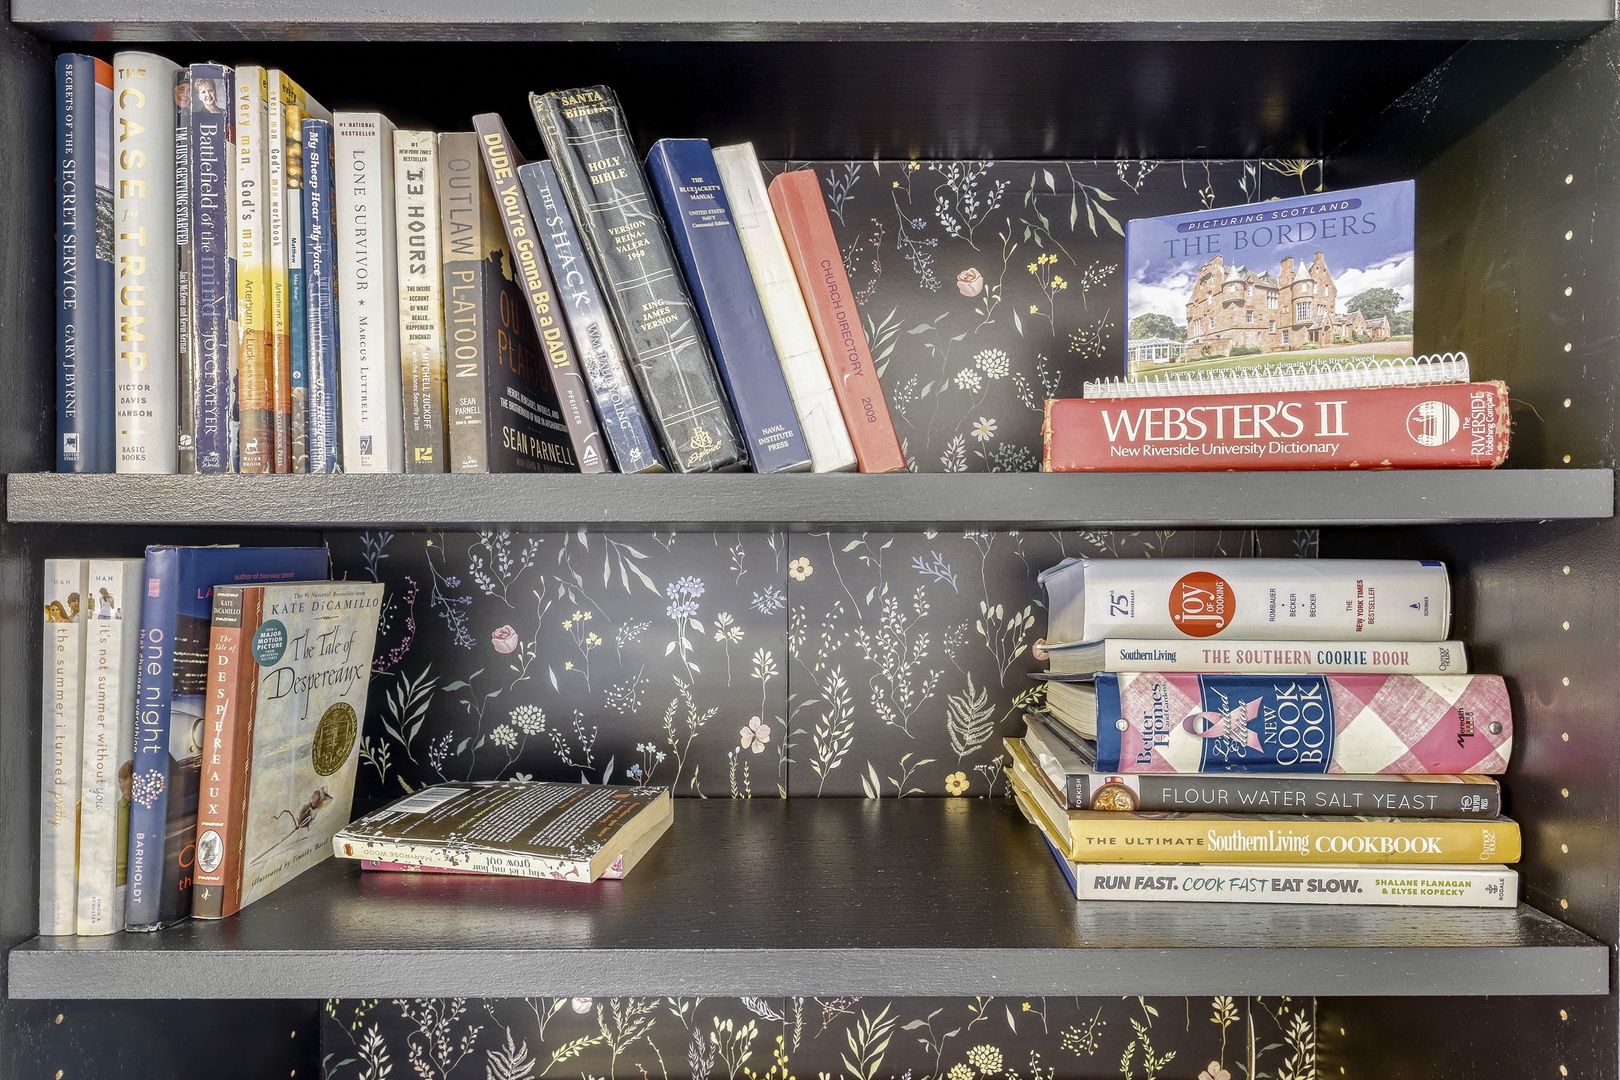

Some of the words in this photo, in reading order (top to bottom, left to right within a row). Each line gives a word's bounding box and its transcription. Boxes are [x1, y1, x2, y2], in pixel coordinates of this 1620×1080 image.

[65, 64, 73, 111] SECRETS
[118, 68, 146, 79] THE
[238, 85, 250, 127] every
[561, 91, 603, 107] SANTA
[564, 102, 609, 119] BIBLIA
[65, 114, 73, 129] OF
[176, 126, 187, 142] I'M
[65, 131, 73, 154] THE
[119, 88, 146, 199] CASE
[176, 144, 187, 165] JUST
[238, 134, 251, 171] man,
[309, 131, 318, 149] My
[200, 122, 219, 209] Battlefield
[310, 150, 321, 188] Sheep
[352, 150, 366, 196] LONE
[484, 132, 513, 185] DUDE,
[587, 156, 621, 173] HOLY
[176, 167, 188, 206] GETTING
[590, 168, 628, 186] BIBLE
[679, 185, 721, 194] BLUEJACKET'S
[62, 159, 77, 232] SECRET
[241, 179, 256, 220] God's
[311, 192, 321, 222] Hear
[447, 158, 474, 256] OUTLAW
[500, 185, 527, 238] You're
[540, 186, 556, 211] THE
[122, 207, 141, 222] for
[177, 206, 188, 245] STARTED
[200, 212, 214, 226] of
[608, 219, 646, 236] VERSION
[1188, 213, 1264, 232] PICTURING
[1271, 200, 1350, 220] SCOTLAND
[200, 227, 215, 253] the
[242, 228, 253, 258] man
[311, 224, 322, 242] My
[354, 204, 369, 290] SURVIVOR
[407, 206, 426, 275] HOURS
[614, 231, 646, 245] REINA-
[615, 238, 651, 254] VALERA
[1164, 233, 1221, 259] THE
[1233, 211, 1377, 251] BORDERS
[312, 242, 323, 276] Voice
[517, 240, 543, 291] Gonna
[546, 215, 590, 309] SHACK
[627, 249, 646, 261] 1960
[63, 234, 77, 310] SERVICE
[201, 256, 221, 317] mind
[120, 226, 147, 372] TRUMP
[532, 293, 550, 314] Be
[641, 298, 665, 312] KING
[642, 306, 671, 322] JAMES
[451, 270, 478, 379] PLATOON
[540, 316, 554, 327] a
[640, 314, 679, 332] VERSION
[65, 324, 76, 362] GARY
[202, 331, 218, 378] JOYCE
[358, 316, 368, 362] MARCUS
[543, 328, 571, 369] DAD!
[820, 259, 844, 310] CHURCH
[835, 311, 864, 378] DIRECTORY
[861, 397, 877, 424] 2009
[65, 372, 76, 418] BYRNE
[118, 384, 151, 392] VICTOR
[120, 397, 147, 405] DAVIS
[360, 367, 369, 423] LUTTRELL
[459, 397, 476, 406] SEAN
[204, 383, 218, 434] MEYER
[455, 407, 482, 415] PARNELL
[566, 389, 582, 426] PFEIFFER
[1101, 400, 1305, 442] WEBSTER'S
[1314, 400, 1349, 437] II
[1470, 392, 1486, 456] RIVERSIDE
[758, 430, 794, 446] INSTITUTE
[761, 424, 785, 435] NAVAL
[768, 441, 789, 452] PRESS
[1110, 444, 1141, 457] New
[1143, 442, 1200, 456] Riverside
[1202, 441, 1266, 458] University
[1268, 441, 1340, 457] Dictionary
[1174, 582, 1225, 629] joy
[1215, 581, 1225, 615] COOKING
[1289, 593, 1297, 618] BECKER
[1309, 593, 1317, 618] BECKER
[1356, 579, 1364, 599] TIMES
[271, 602, 305, 615] KATE
[311, 597, 379, 612] DiCAMILLO
[1206, 602, 1215, 613] OF
[1356, 599, 1364, 618] YORK
[56, 628, 69, 653] the
[99, 624, 111, 644] it's
[1356, 618, 1364, 632] NEW
[98, 649, 109, 671] not
[147, 628, 164, 676] one
[290, 627, 315, 661] The
[316, 624, 341, 657] Tale
[342, 630, 358, 664] of
[1120, 649, 1154, 661] Southern
[1153, 649, 1177, 663] Living
[1202, 650, 1231, 664] THE
[1236, 650, 1312, 665] SOUTHERN
[1317, 650, 1368, 665] COOKIE
[1372, 651, 1410, 665] BOOK
[56, 659, 65, 718] summer
[97, 676, 107, 729] summer
[262, 663, 364, 721] Despereaux
[141, 687, 165, 755] night
[1154, 683, 1170, 749] Homes
[1263, 704, 1277, 745] NEW
[1274, 681, 1301, 766] COOK
[1299, 681, 1325, 764] BOOK
[1457, 707, 1466, 749] Meredith
[207, 655, 229, 815] DESPEREAUX
[1136, 710, 1154, 765] Better
[54, 734, 66, 786] turned
[96, 732, 108, 784] without
[1162, 787, 1229, 804] FLOUR
[1237, 789, 1306, 807] WATER
[1315, 791, 1364, 808] SALT
[1373, 793, 1438, 811] YEAST
[1086, 837, 1117, 845] THE
[1125, 837, 1204, 846] ULTIMATE
[1207, 829, 1268, 852] Southern
[1268, 830, 1310, 857] Living
[1315, 836, 1443, 854] COOKBOOK
[133, 832, 145, 904] BARNHOLDT
[1093, 875, 1131, 890] RUN
[1134, 875, 1179, 891] FAST.
[1182, 876, 1225, 892] COOK
[1228, 876, 1269, 893] FAST
[1271, 878, 1303, 893] EAT
[1306, 878, 1363, 894] SLOW.
[1375, 878, 1419, 887] SHALANE
[1421, 880, 1472, 888] FLANAGAN
[1381, 887, 1389, 895] &
[1391, 887, 1418, 896] ELYSE
[1420, 888, 1465, 896] KOPECKY
